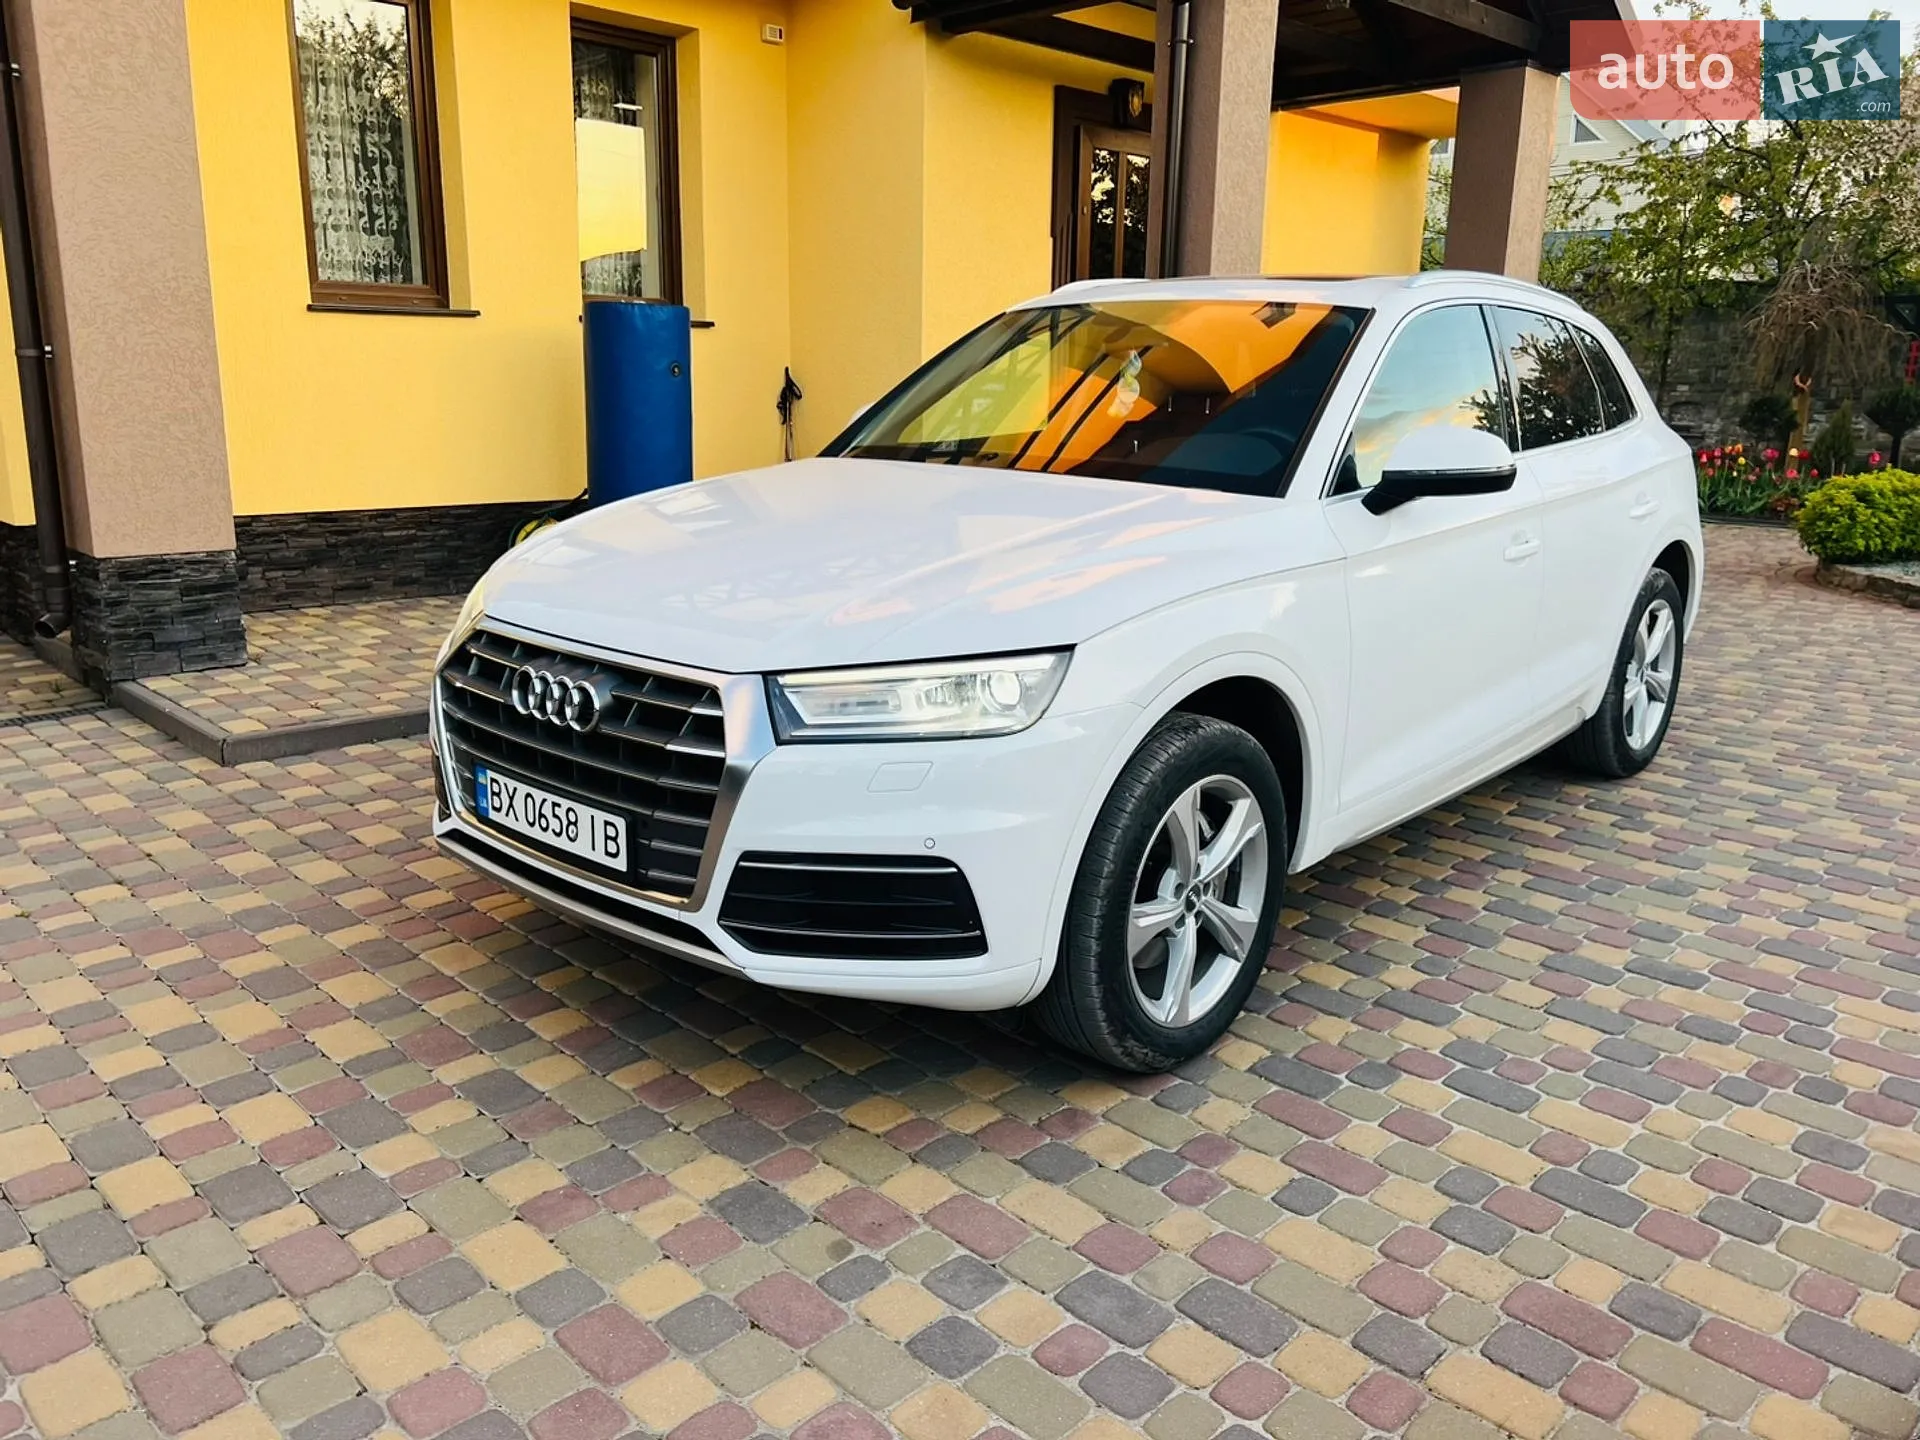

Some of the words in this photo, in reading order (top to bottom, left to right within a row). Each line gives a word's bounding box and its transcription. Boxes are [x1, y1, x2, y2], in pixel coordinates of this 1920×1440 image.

[489, 777, 519, 822] BX
[524, 792, 579, 843] 0658
[590, 815, 620, 859] IB
